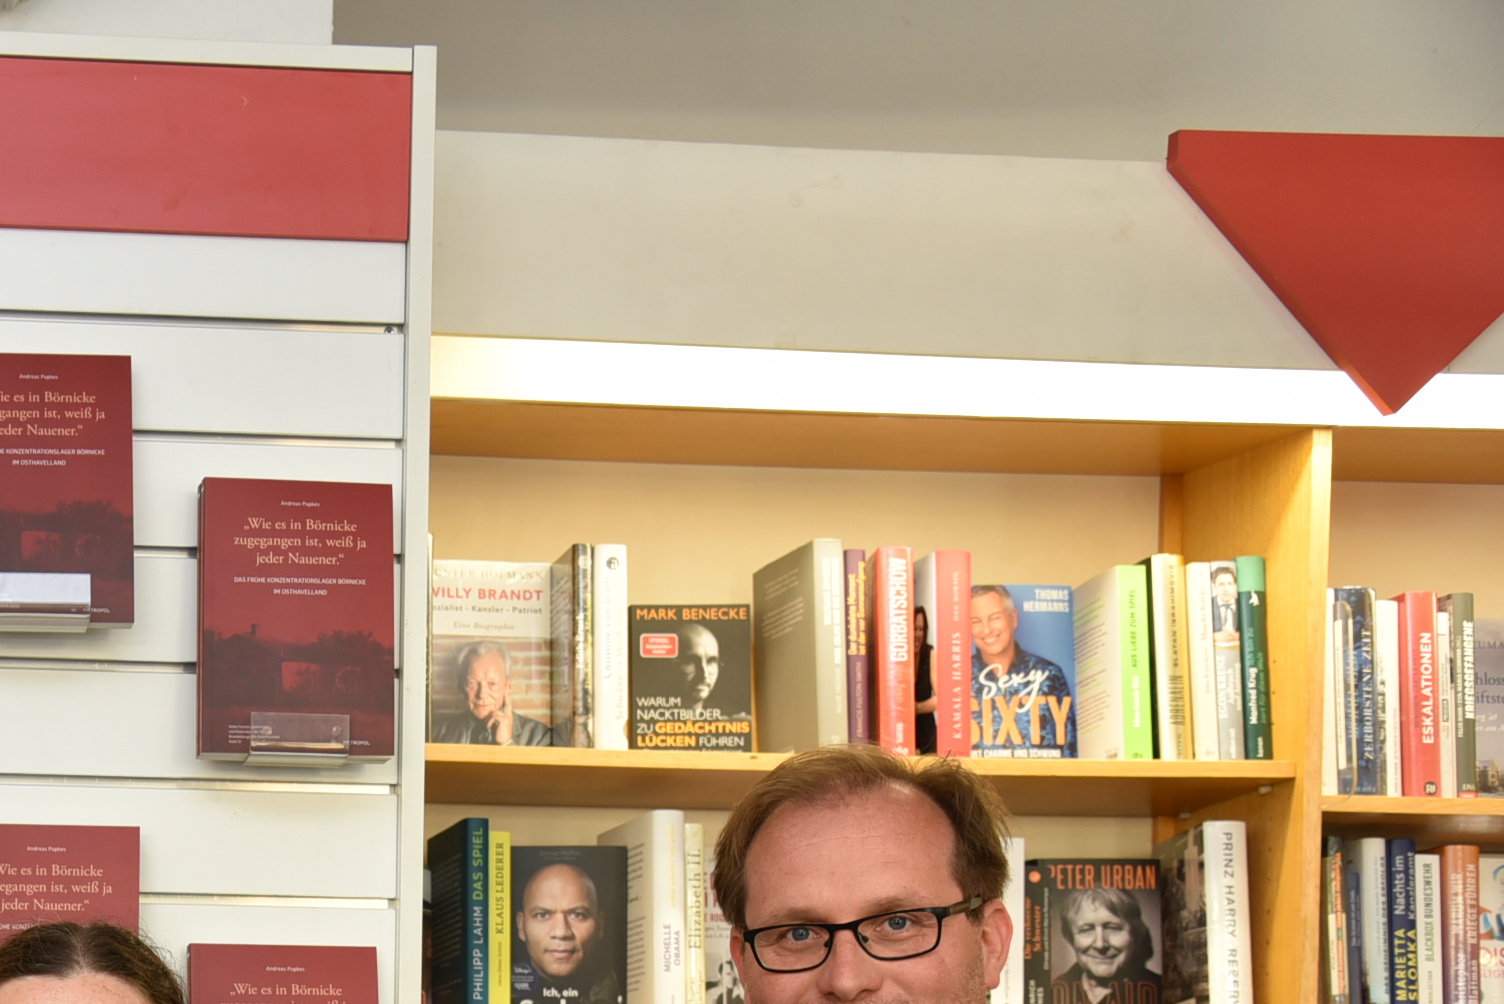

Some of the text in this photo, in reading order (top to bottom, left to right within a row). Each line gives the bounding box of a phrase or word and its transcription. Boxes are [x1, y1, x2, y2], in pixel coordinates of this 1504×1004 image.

[478, 588, 543, 601] BRANDT
[636, 607, 747, 621] MARK BENECKE
[889, 557, 908, 662] GORBATSCHOW
[1023, 601, 1069, 612] HERMANNS
[1035, 589, 1069, 600] THOMAS
[636, 696, 681, 707] WARUM
[952, 631, 962, 740] KAMALA HARRIS
[979, 664, 1048, 713] Sexy
[1420, 632, 1434, 744] ESKALATIONEN
[636, 720, 750, 734] ZU GEDÄCHTNIS
[637, 708, 721, 720] NACKTBILDER
[971, 695, 1072, 746] SIXTY
[638, 734, 744, 747] LÜCKEN FÜHREN
[495, 842, 505, 935] KLAUS LEDERER
[1101, 865, 1156, 890] URBAN
[1222, 832, 1237, 938] PRINZ HARRY
[473, 827, 484, 1000] PHILIPP LAHM DAS SPIEL
[688, 872, 702, 950] Elizabeth
[663, 924, 671, 972] MICHELLE
[1395, 928, 1406, 1001] MARIETTA
[1408, 930, 1418, 1001] SLOMKA
[543, 987, 578, 999] Ich, ein
